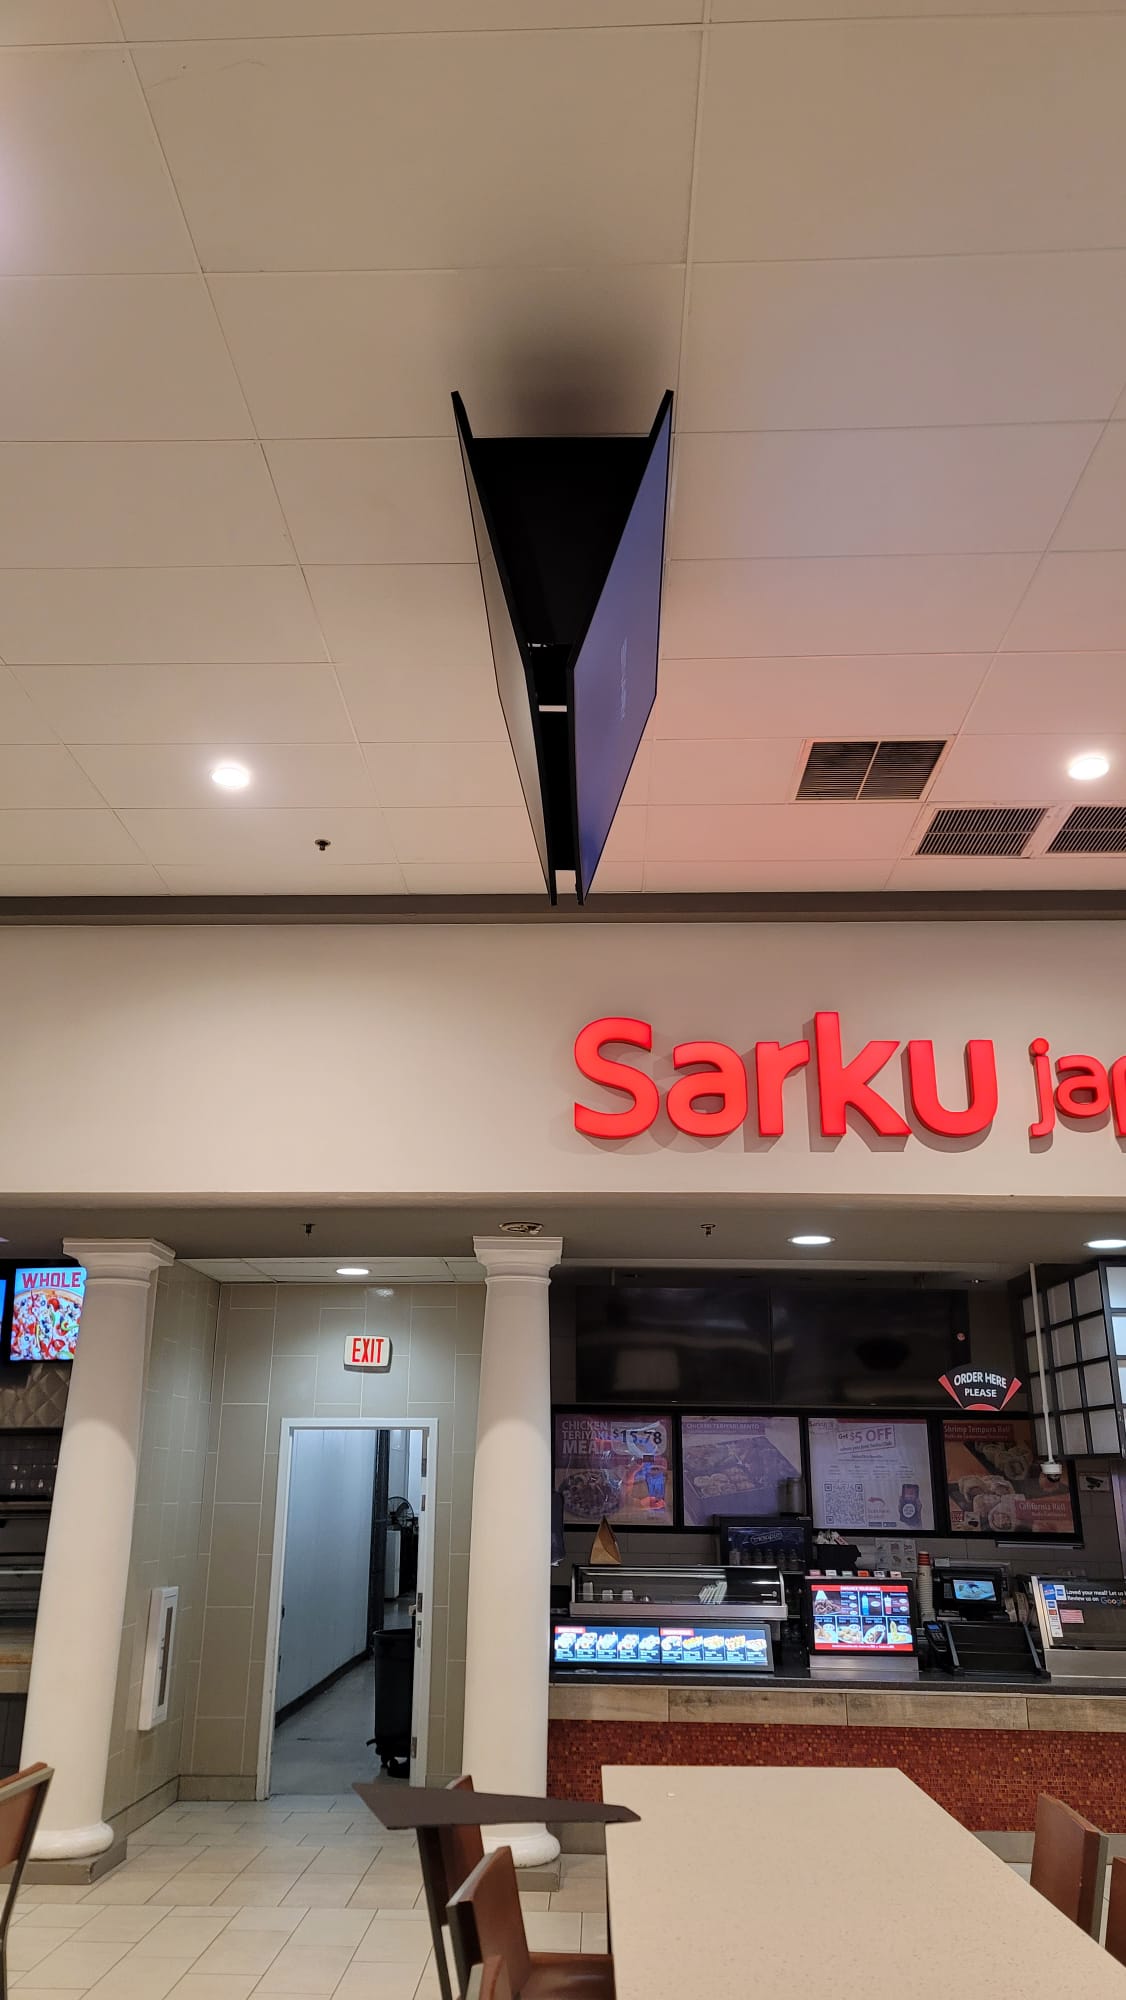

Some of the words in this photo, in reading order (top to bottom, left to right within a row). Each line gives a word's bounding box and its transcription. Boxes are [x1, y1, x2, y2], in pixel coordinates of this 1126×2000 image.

[574, 1012, 998, 1138] Sarku
[22, 1272, 81, 1288] WHOLE
[352, 1338, 384, 1363] EXIT
[954, 1372, 983, 1386] ORDER
[985, 1373, 1007, 1389] HERE
[965, 1388, 997, 1397] PLEASE
[562, 1421, 608, 1430] CHICKEN
[968, 1425, 996, 1434] Tempura
[613, 1429, 662, 1445] $15.78
[866, 1427, 892, 1441] OFF
